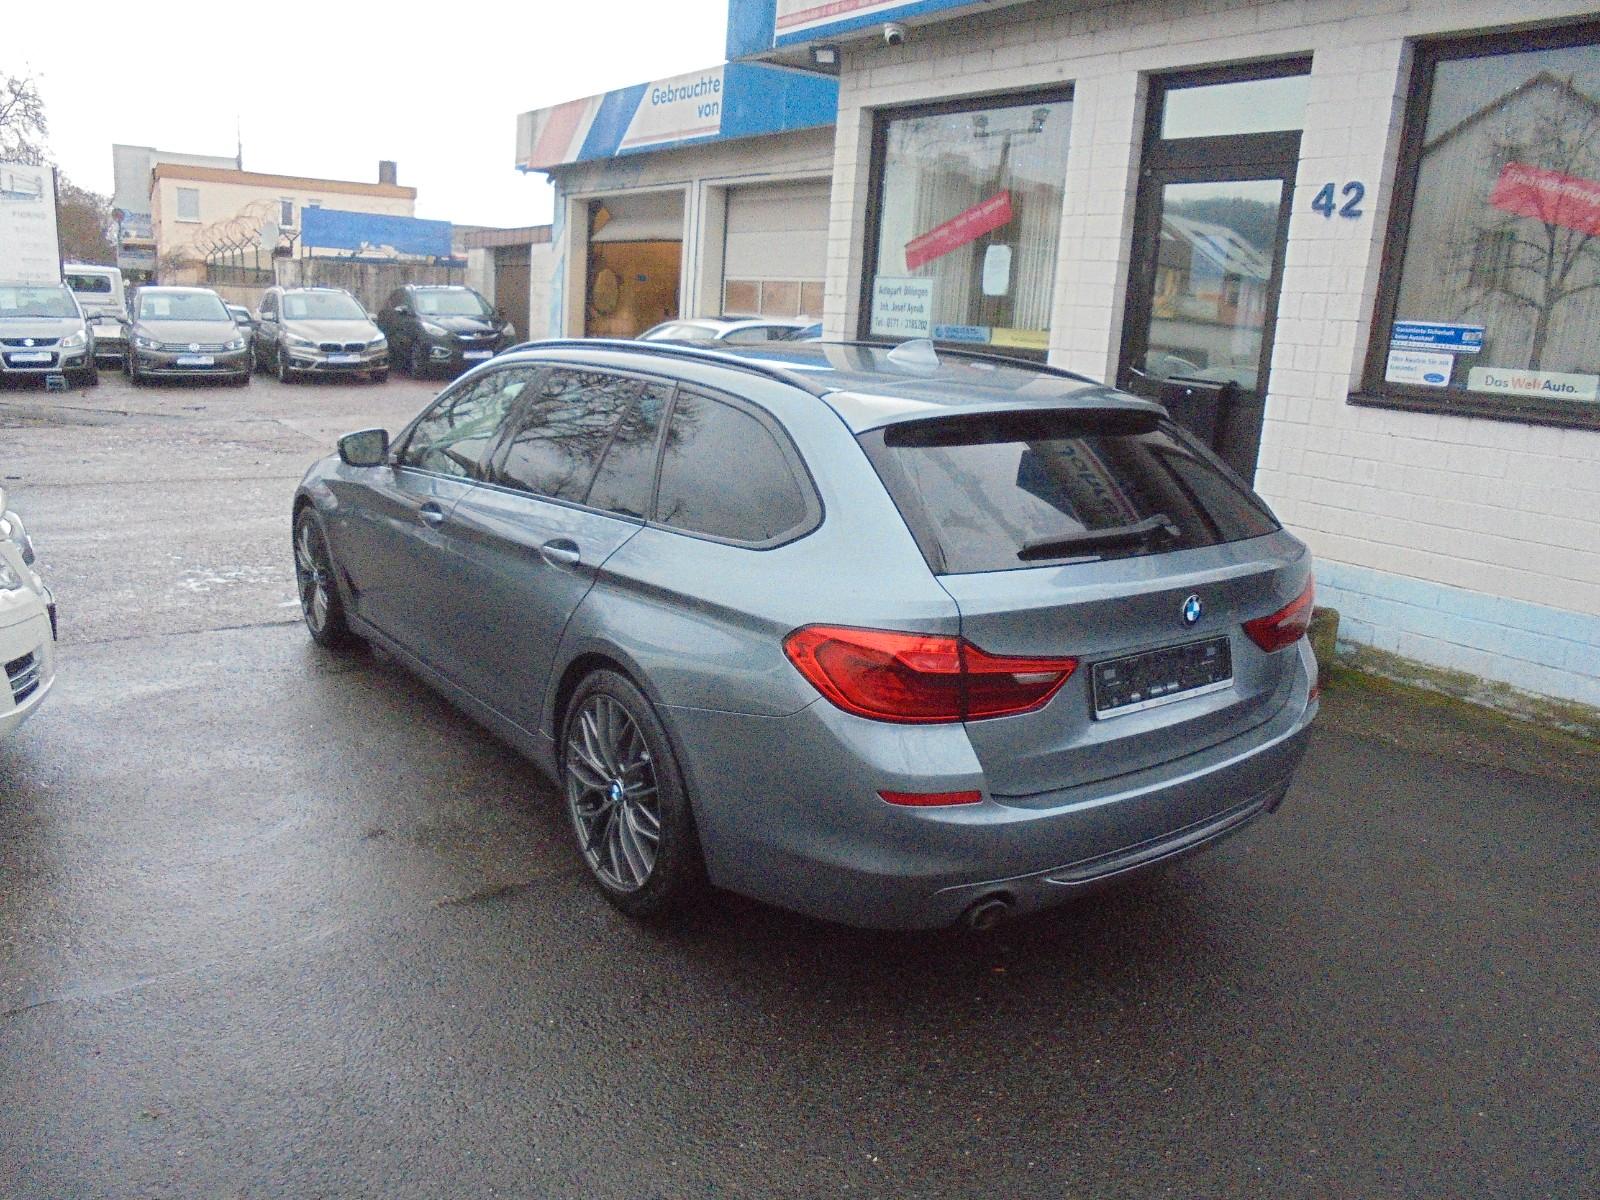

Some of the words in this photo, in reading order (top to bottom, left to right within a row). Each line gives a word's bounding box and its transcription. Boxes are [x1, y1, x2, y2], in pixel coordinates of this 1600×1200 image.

[651, 77, 720, 106] Gebrauchte
[698, 101, 719, 118] von
[1311, 181, 1366, 218] 42
[1484, 374, 1509, 388] Das
